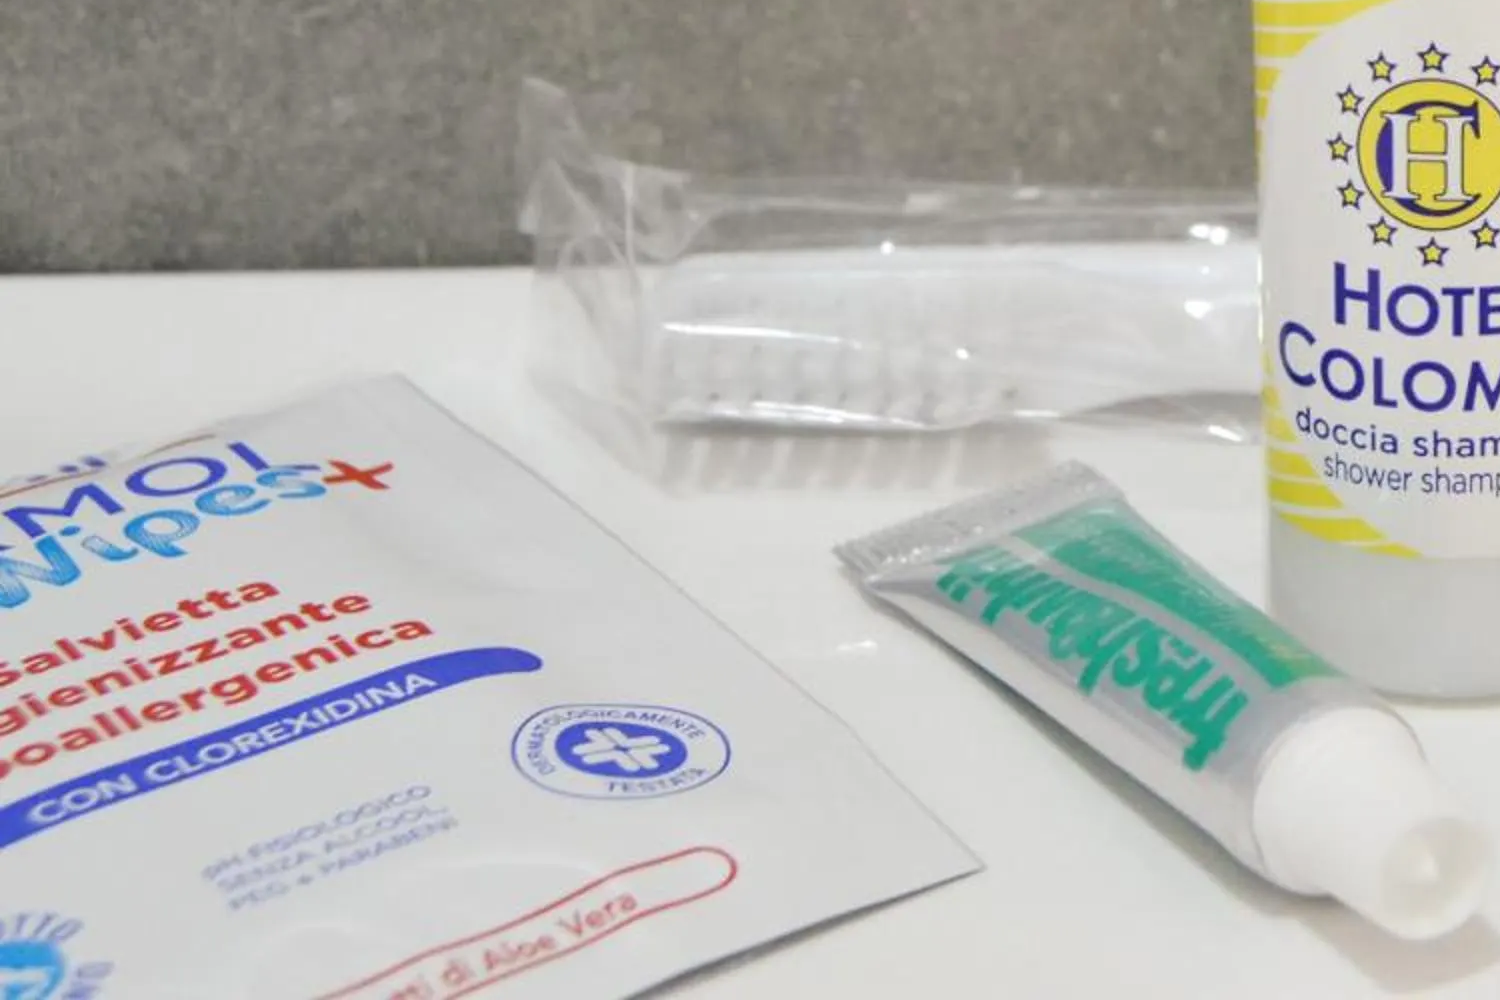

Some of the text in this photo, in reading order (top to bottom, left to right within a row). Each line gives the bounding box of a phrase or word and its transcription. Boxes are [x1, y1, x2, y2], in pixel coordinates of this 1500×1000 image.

[1295, 407, 1399, 456] doccia
[1323, 452, 1413, 492] shower
[27, 672, 439, 824] CON CLOREXIDINA
[606, 767, 706, 793] TESTATA
[247, 784, 432, 859] FISIOLOGICO
[216, 852, 317, 892] SENZA
[228, 880, 292, 910] PEG
[318, 815, 459, 877] PARABENI
[482, 935, 557, 972] Aloe
[556, 893, 638, 938] Vera
